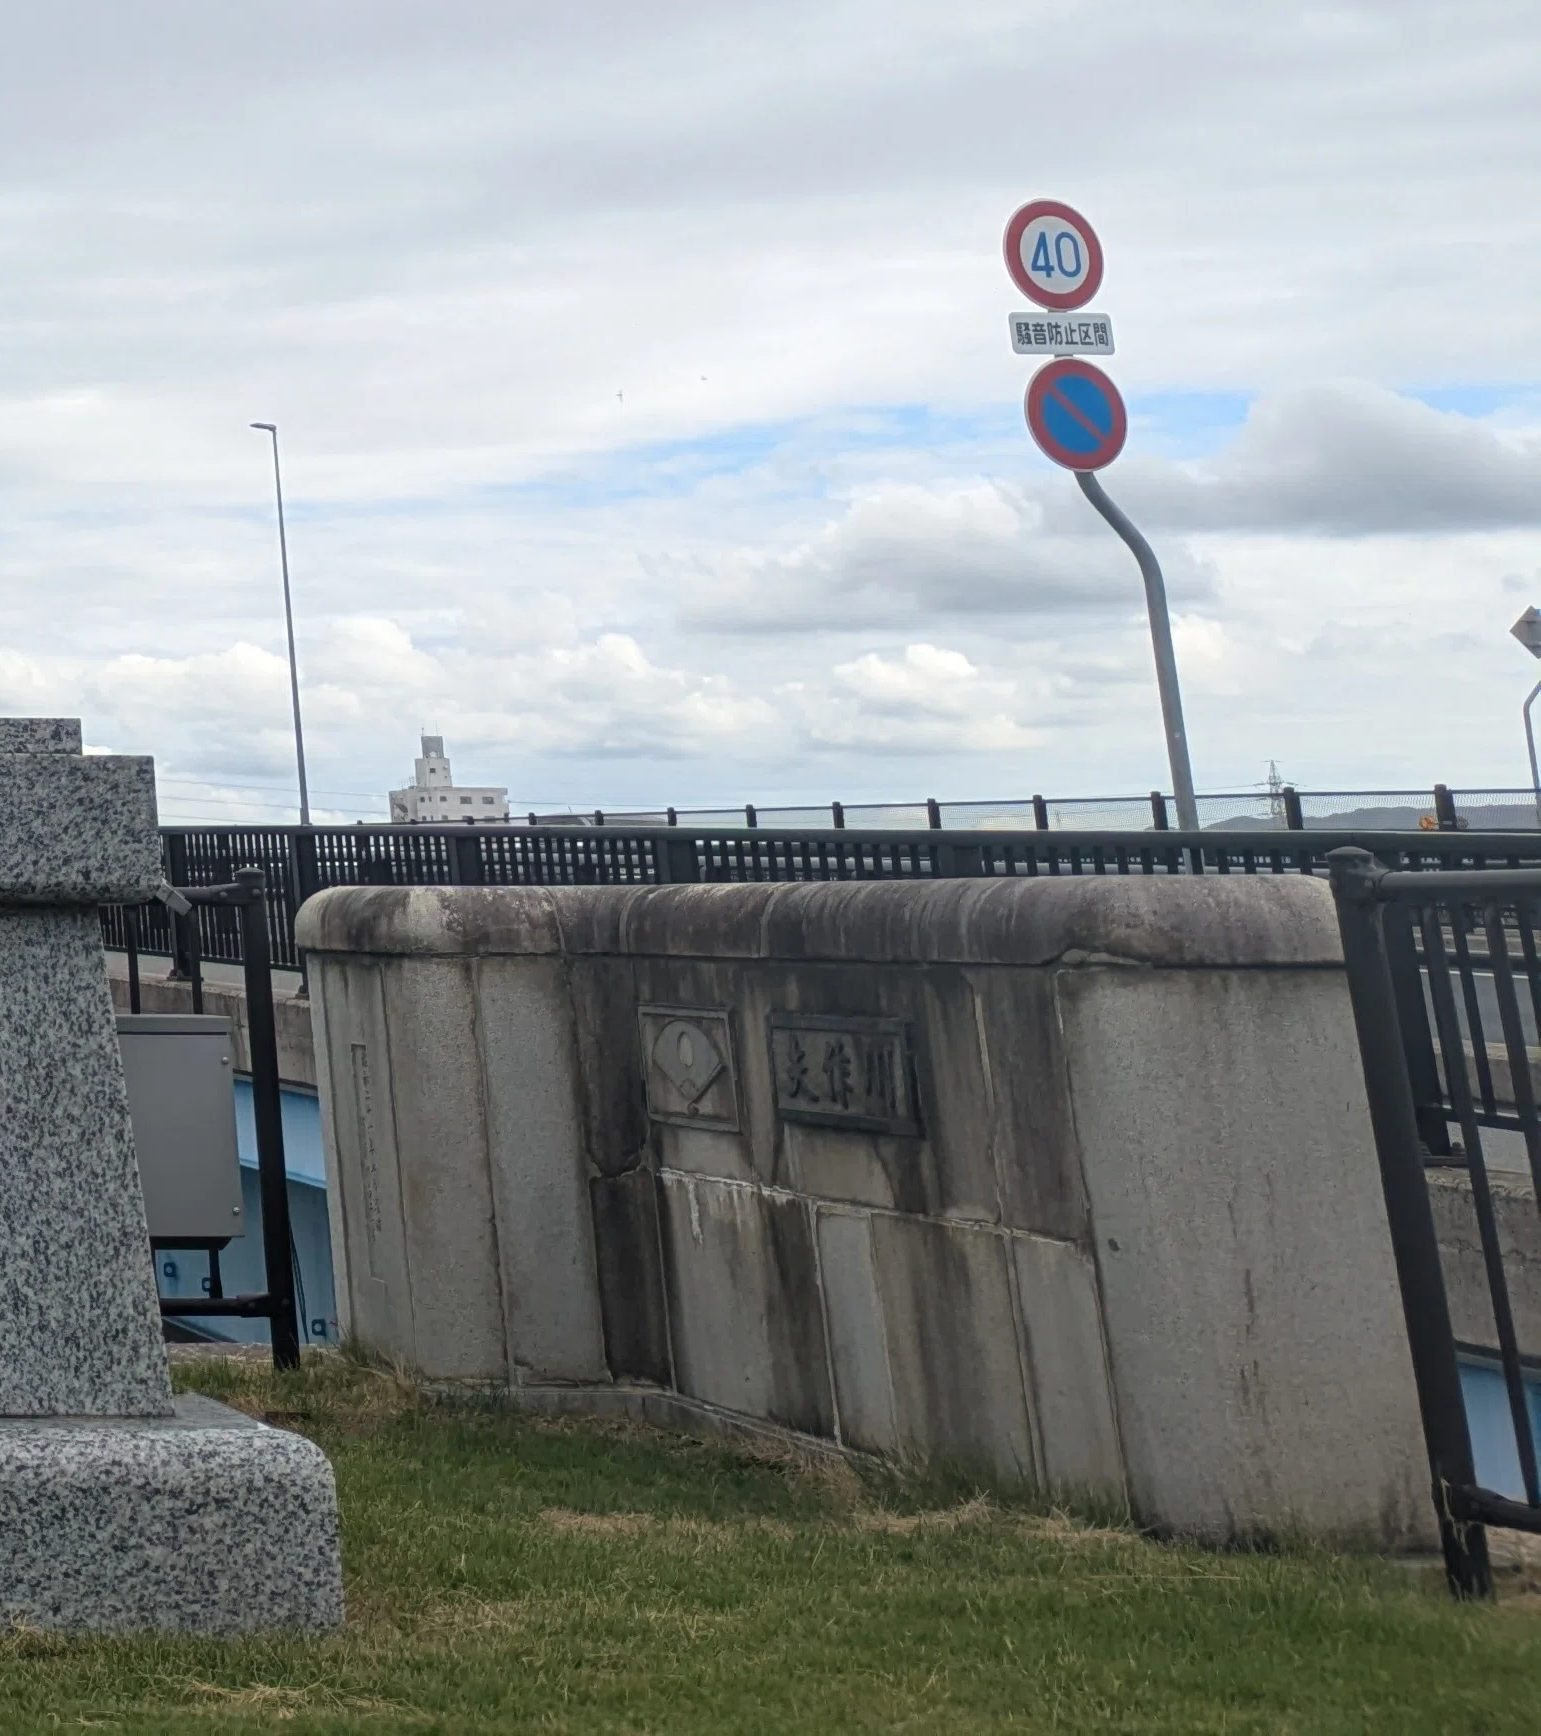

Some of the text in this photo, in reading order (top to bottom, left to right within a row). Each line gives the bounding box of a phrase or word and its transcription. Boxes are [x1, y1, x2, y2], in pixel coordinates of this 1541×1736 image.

[1031, 231, 1082, 278] 40
[1015, 322, 1109, 346] 騒音防止区間
